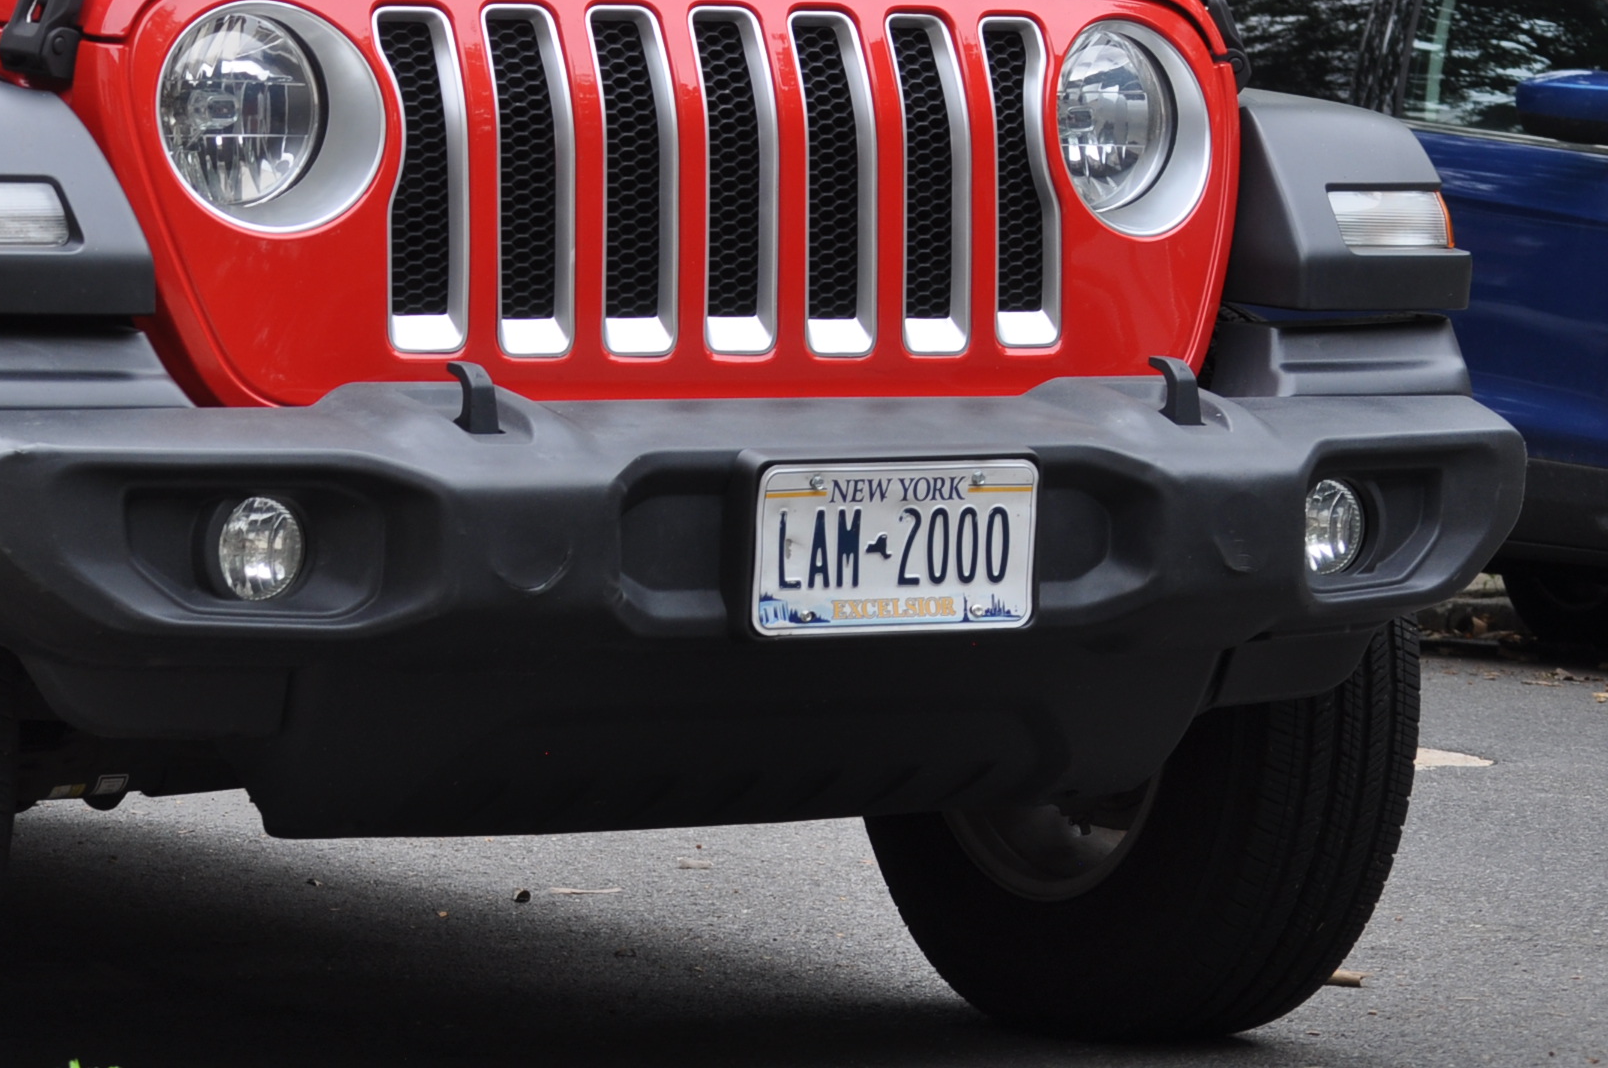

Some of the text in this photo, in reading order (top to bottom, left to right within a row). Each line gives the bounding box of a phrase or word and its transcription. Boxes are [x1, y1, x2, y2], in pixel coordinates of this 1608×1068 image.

[829, 475, 967, 504] NEW YORK
[778, 505, 1011, 590] LAM 2000
[831, 595, 957, 621] EXCELSIOR
